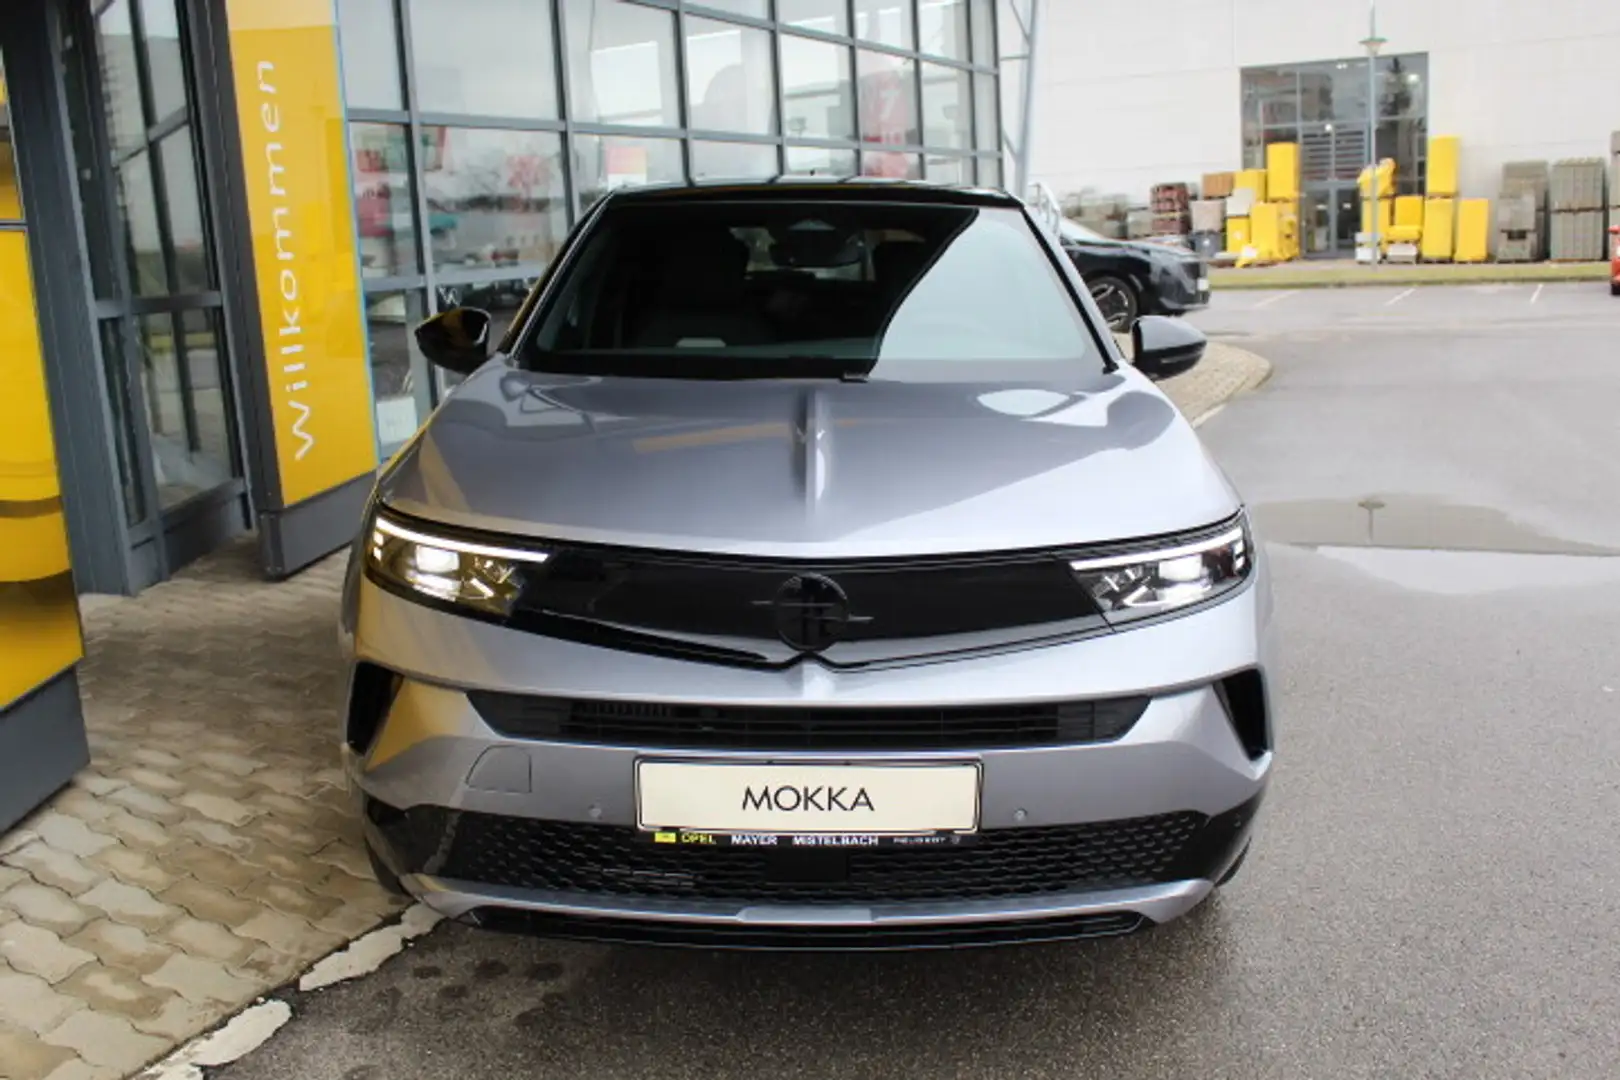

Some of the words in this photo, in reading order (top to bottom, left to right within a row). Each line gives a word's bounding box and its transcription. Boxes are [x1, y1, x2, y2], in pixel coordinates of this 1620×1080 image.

[741, 785, 875, 812] MOKKA
[681, 832, 717, 845] OPEL
[730, 834, 778, 846] MAYER
[791, 834, 879, 846] MISTELBACH
